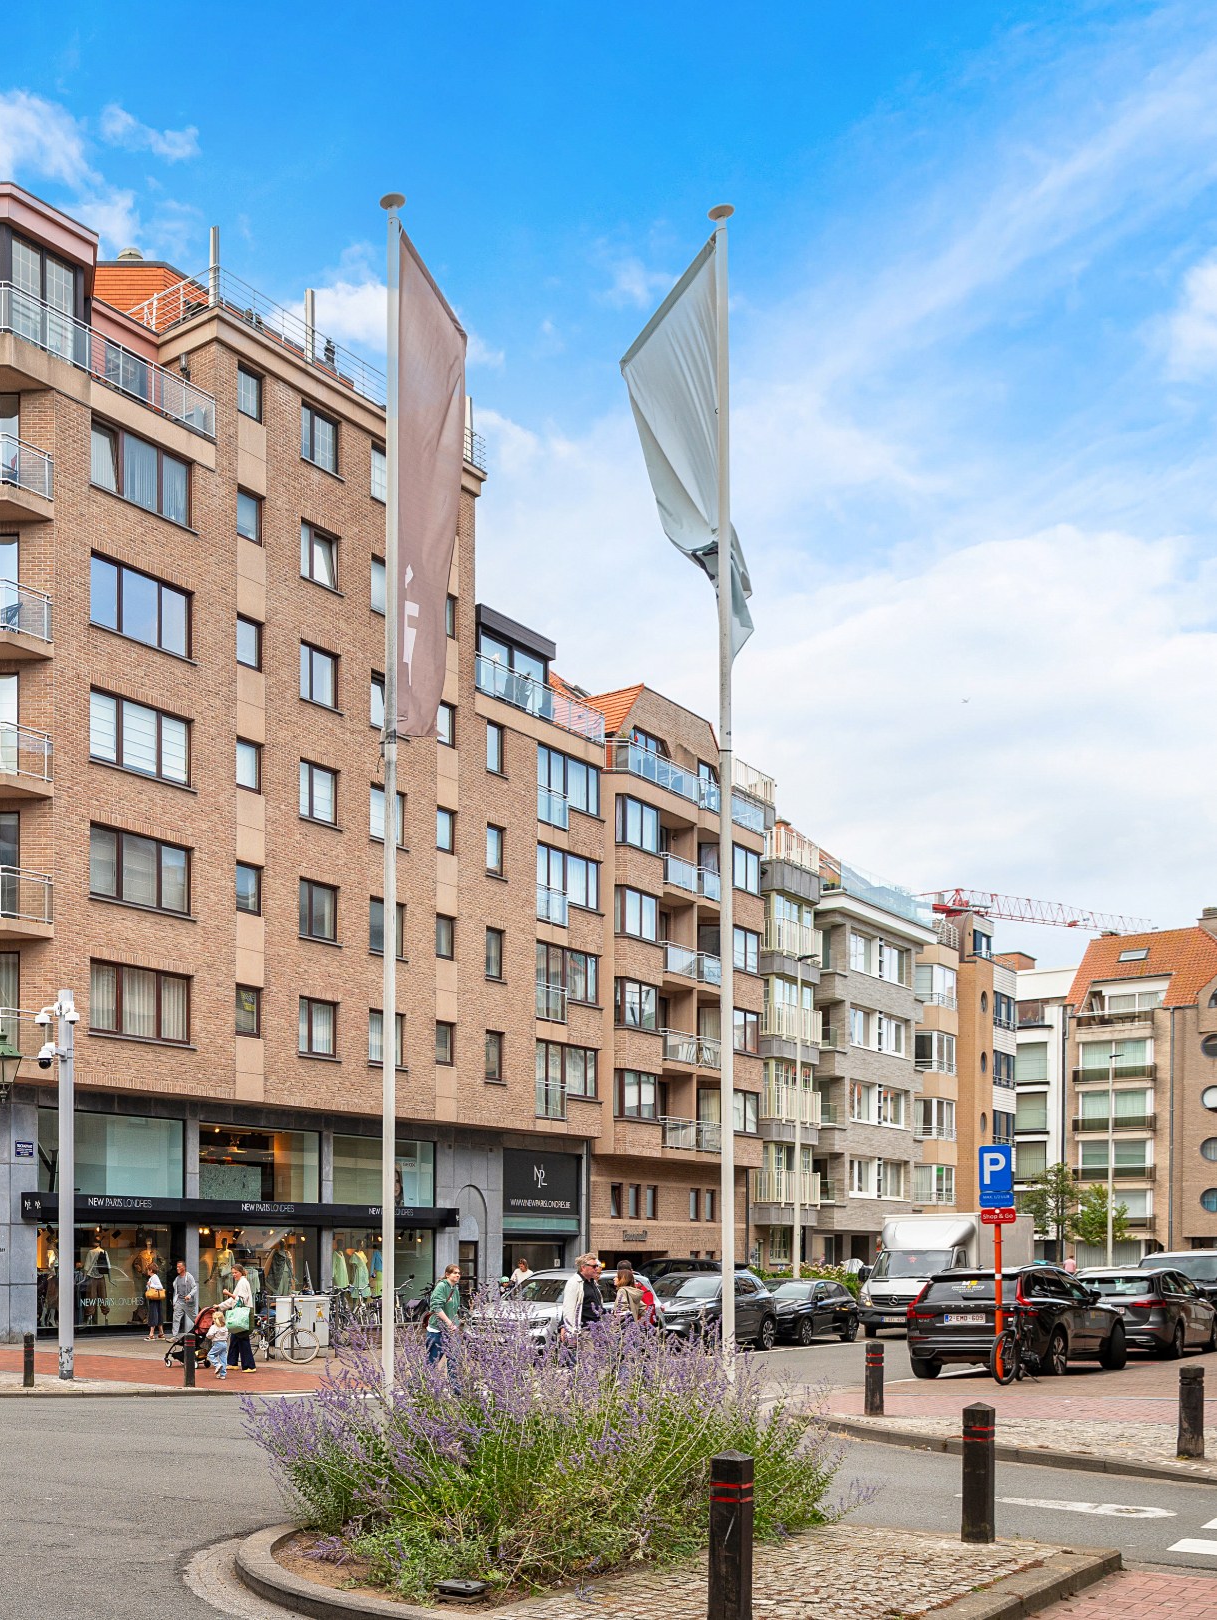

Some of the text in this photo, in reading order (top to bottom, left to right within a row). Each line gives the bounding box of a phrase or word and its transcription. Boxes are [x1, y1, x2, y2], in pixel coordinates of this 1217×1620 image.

[983, 1153, 1006, 1184] P
[88, 1198, 152, 1208] NEW PARIS LONDRES
[241, 1203, 295, 1213] NEW PARIS LONDRES
[369, 1207, 381, 1215] NEW
[81, 1299, 97, 1307] NEW
[97, 1298, 114, 1307] PARIS
